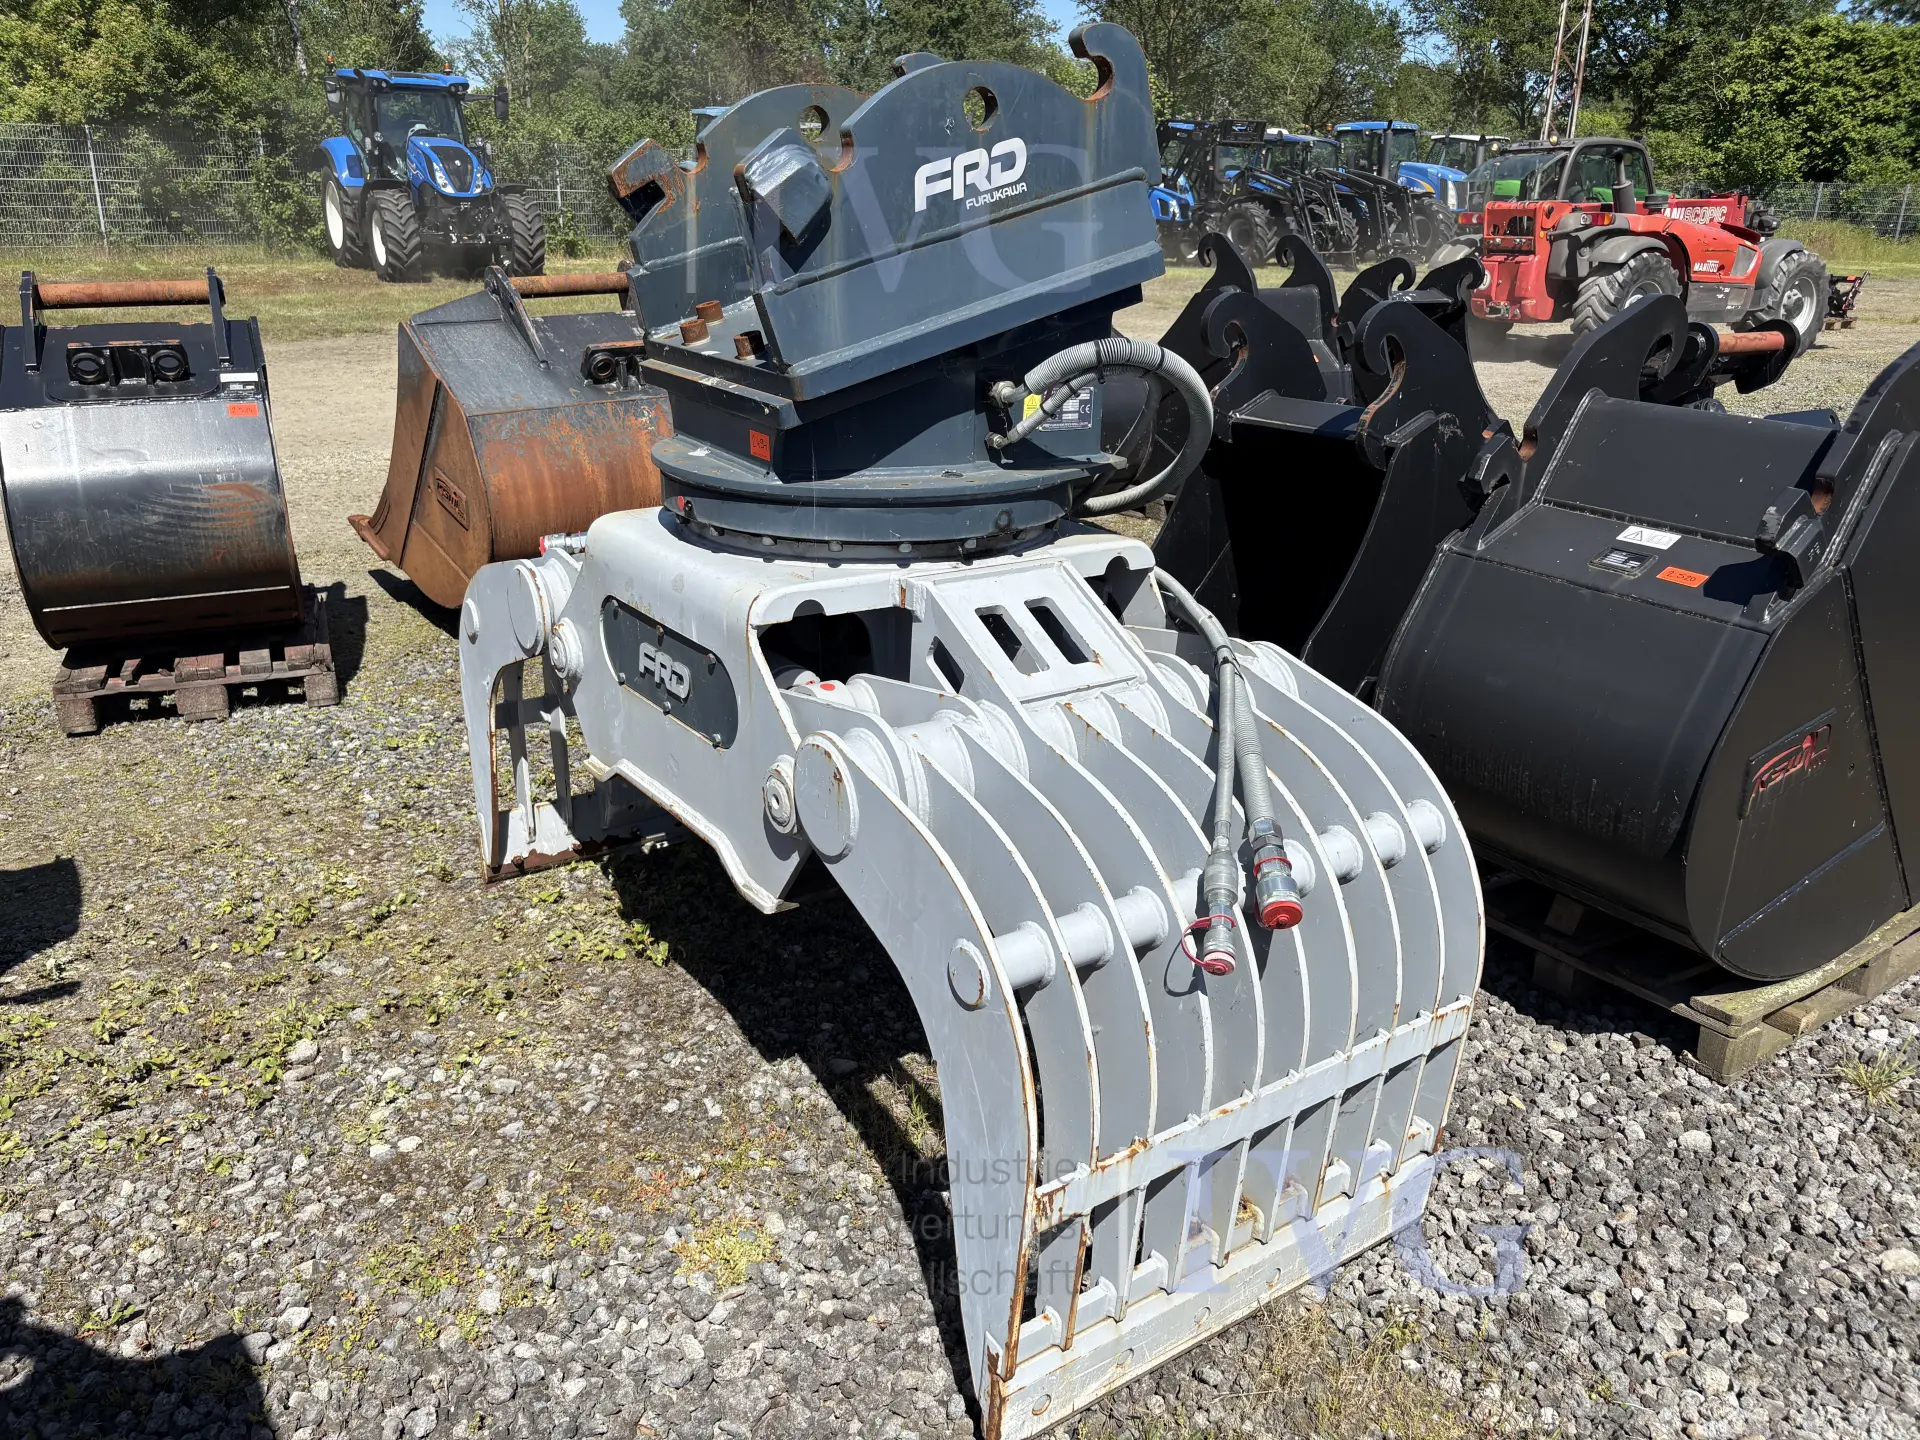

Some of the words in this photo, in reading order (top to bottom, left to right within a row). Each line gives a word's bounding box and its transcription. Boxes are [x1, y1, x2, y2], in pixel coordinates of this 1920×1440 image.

[914, 137, 1027, 213] FRD
[965, 181, 1028, 210] FURUKAWA
[1661, 205, 1728, 225] ANISCOPIC
[639, 642, 692, 699] FRD
